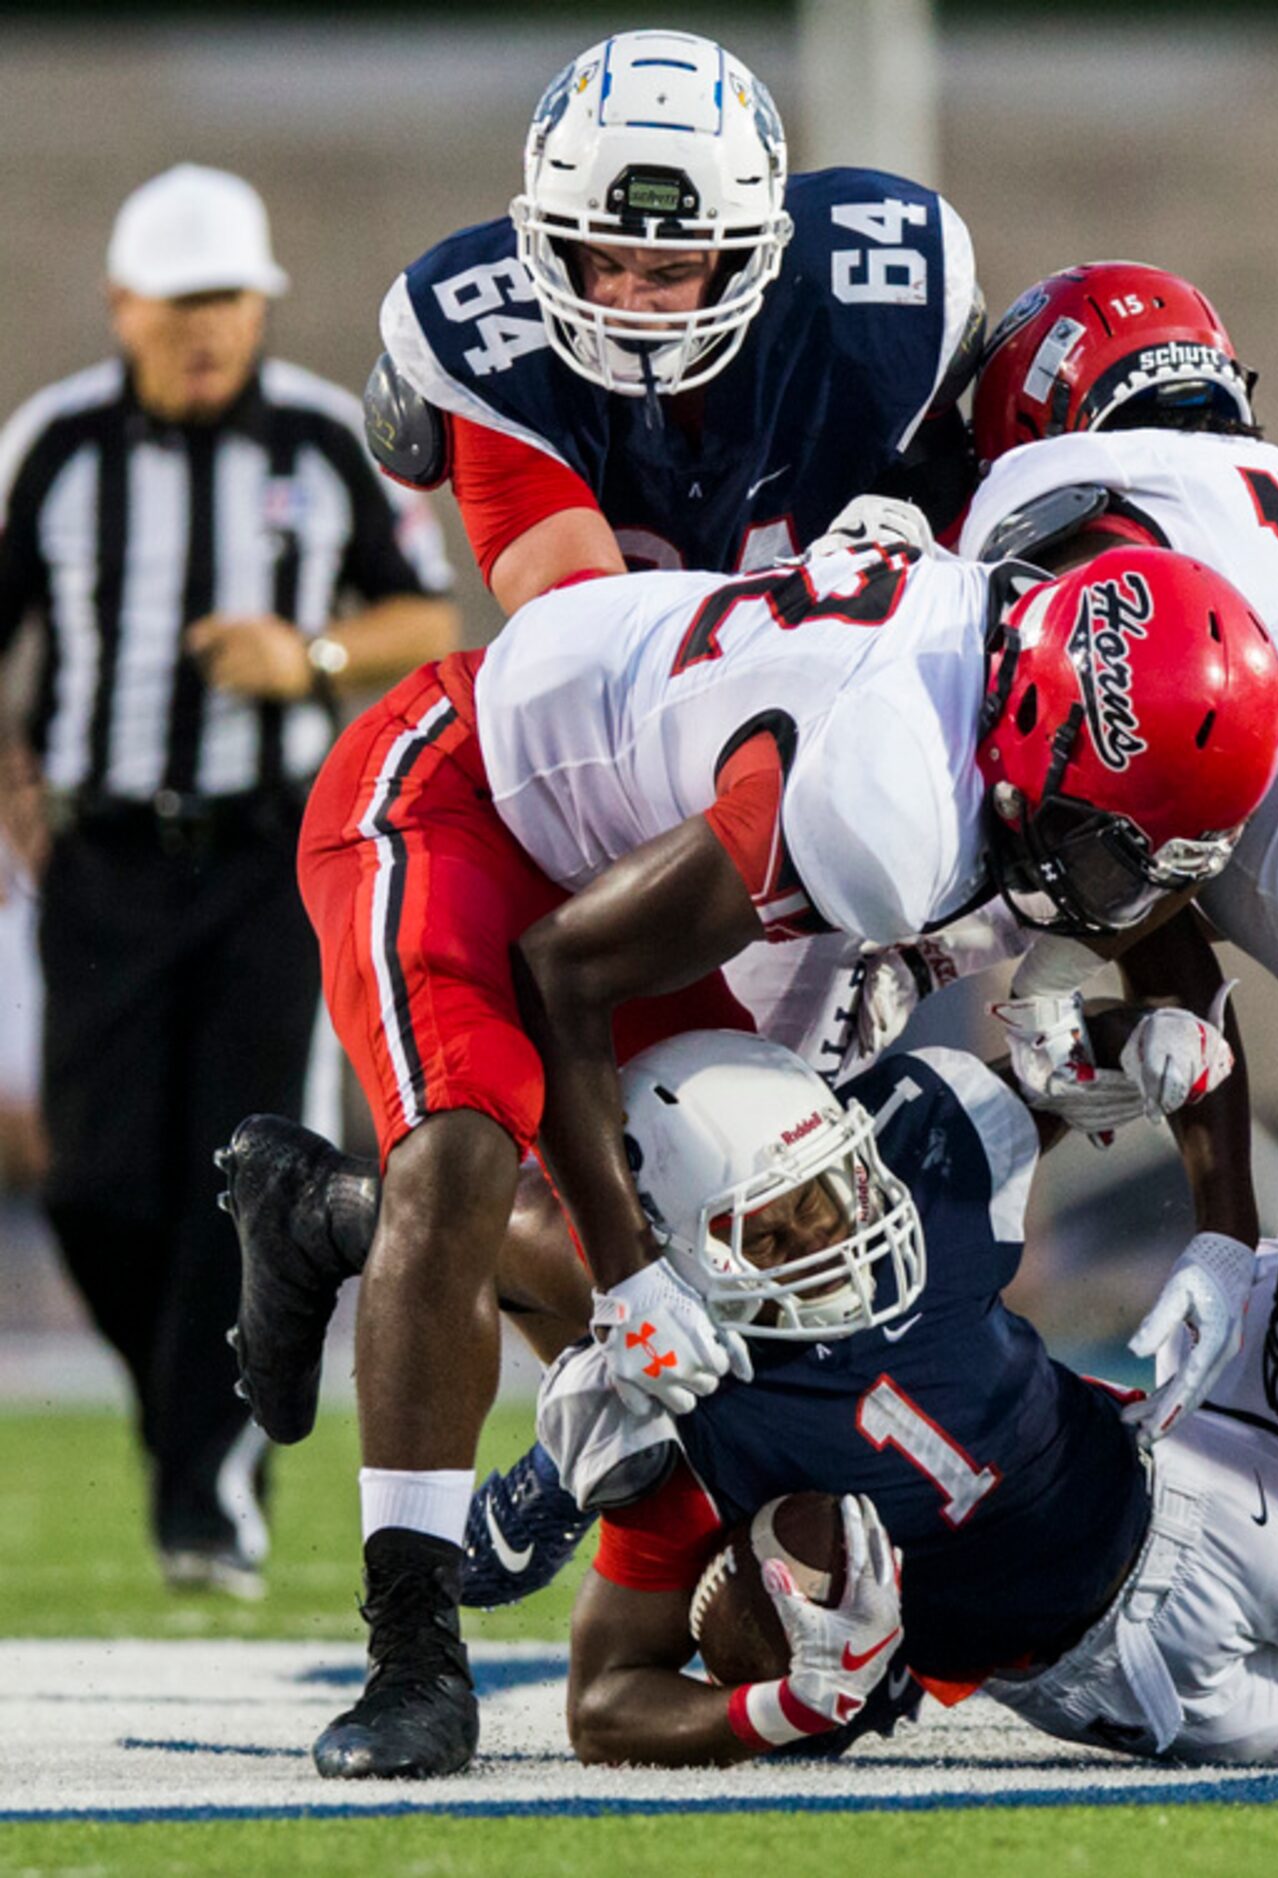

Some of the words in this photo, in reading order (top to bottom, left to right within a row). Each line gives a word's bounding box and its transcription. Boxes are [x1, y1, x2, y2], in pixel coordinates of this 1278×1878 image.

[831, 197, 928, 306] 64
[1110, 294, 1144, 318] 15
[432, 256, 547, 376] 64
[1138, 341, 1222, 371] schutt
[1074, 571, 1154, 774] Horns
[855, 1372, 1001, 1530] 1
